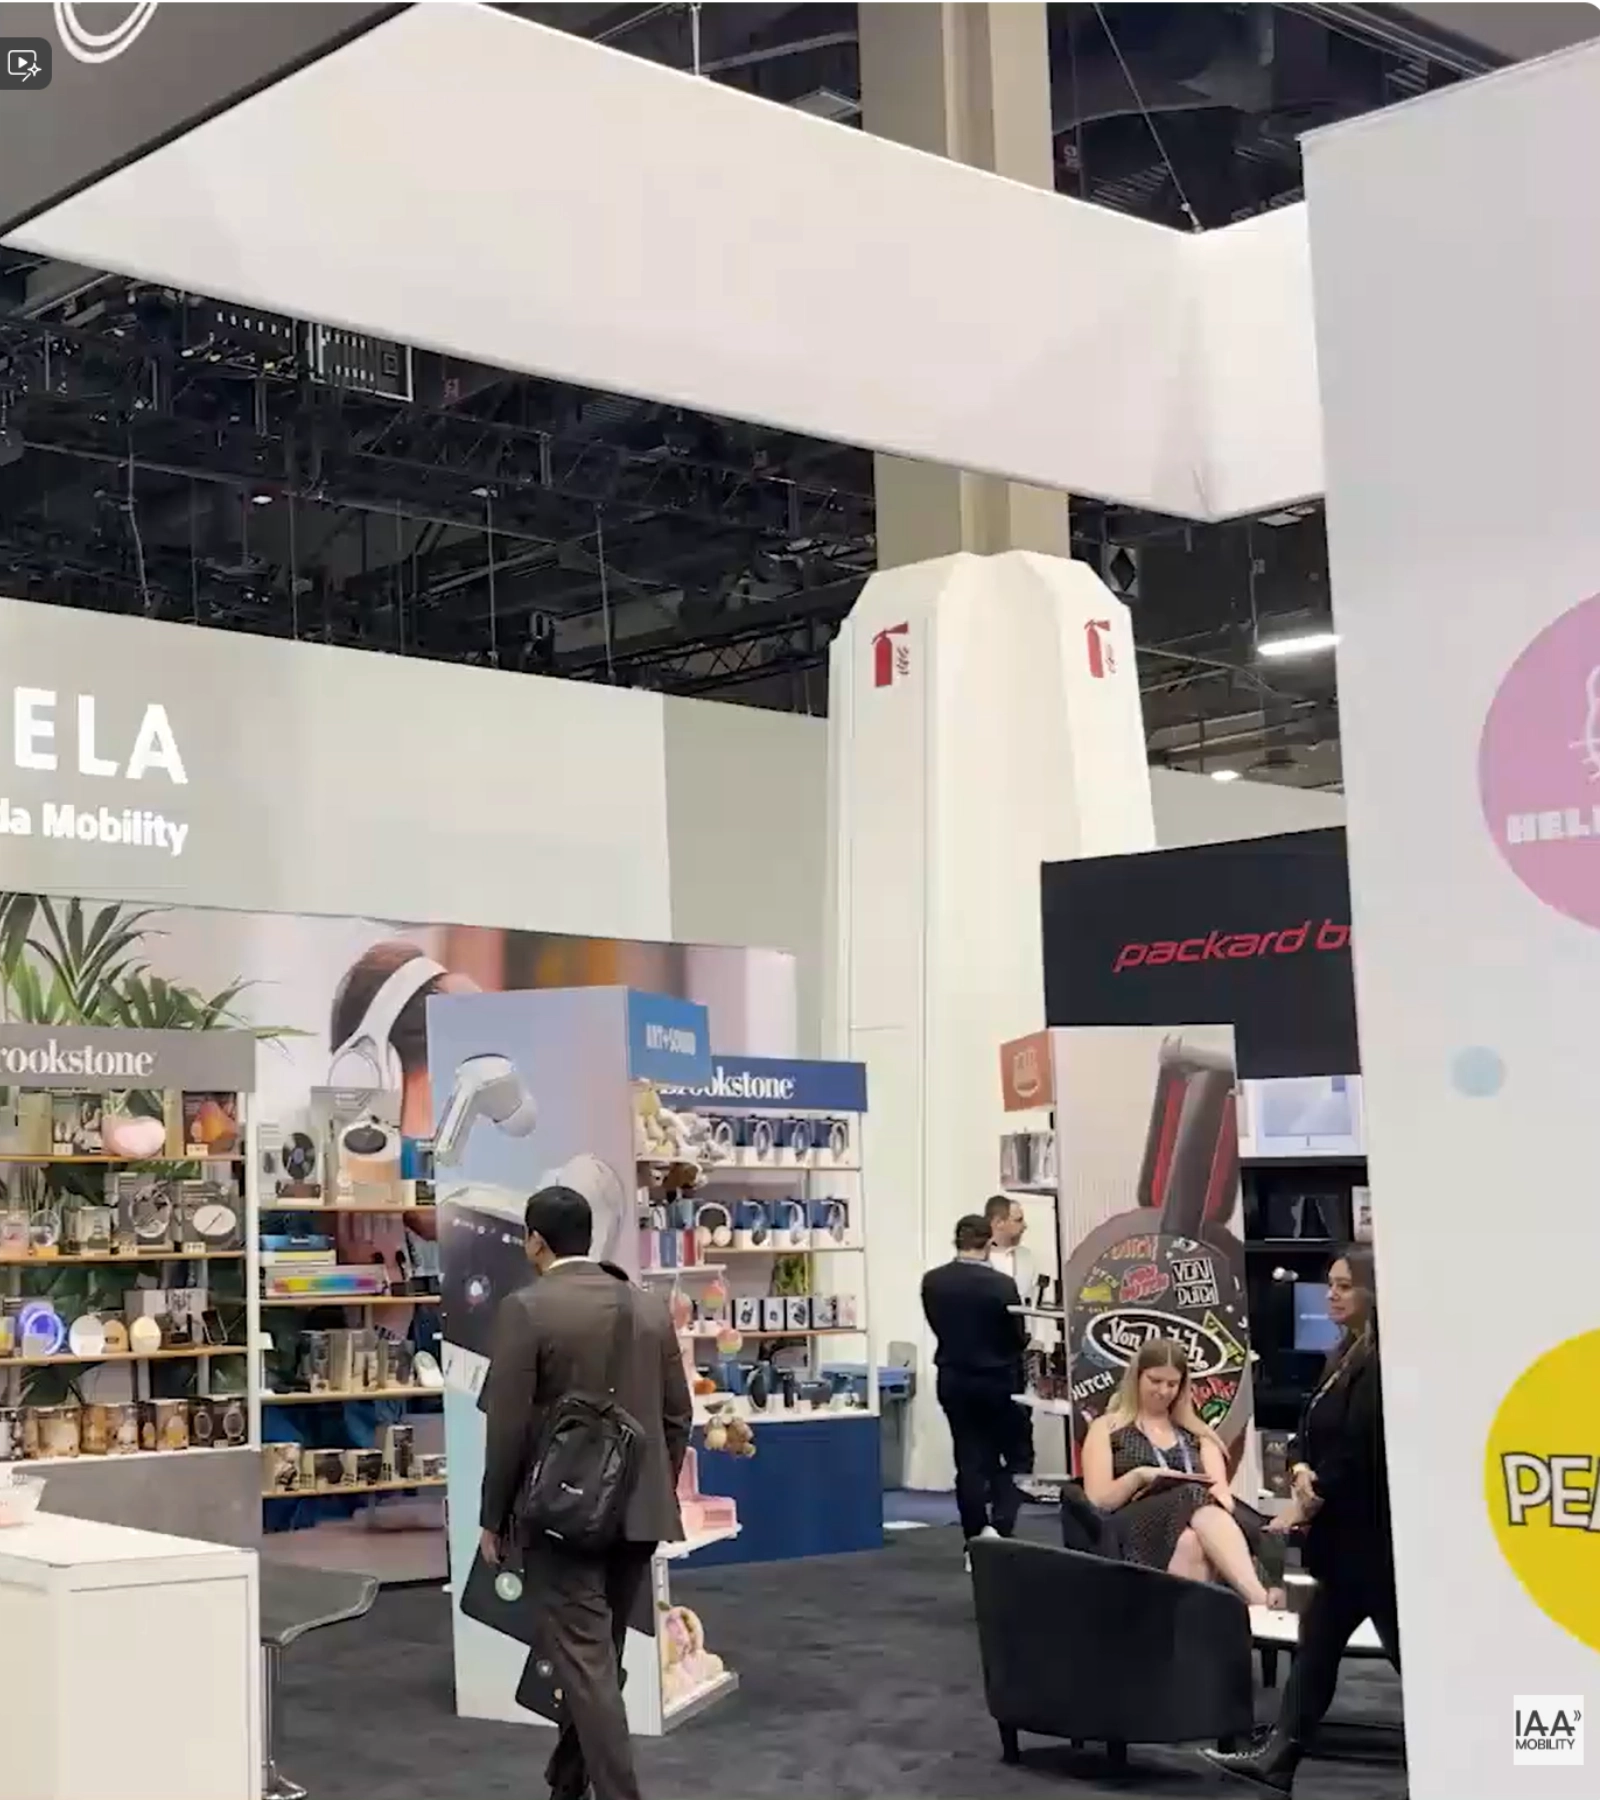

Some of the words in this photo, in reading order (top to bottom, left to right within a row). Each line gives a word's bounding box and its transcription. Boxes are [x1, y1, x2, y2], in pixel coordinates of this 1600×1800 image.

[42, 802, 189, 856] Mobility
[1113, 922, 1311, 974] packard
[1315, 920, 1352, 950] b
[659, 1066, 794, 1100] okstone
[1102, 1317, 1141, 1349] Von
